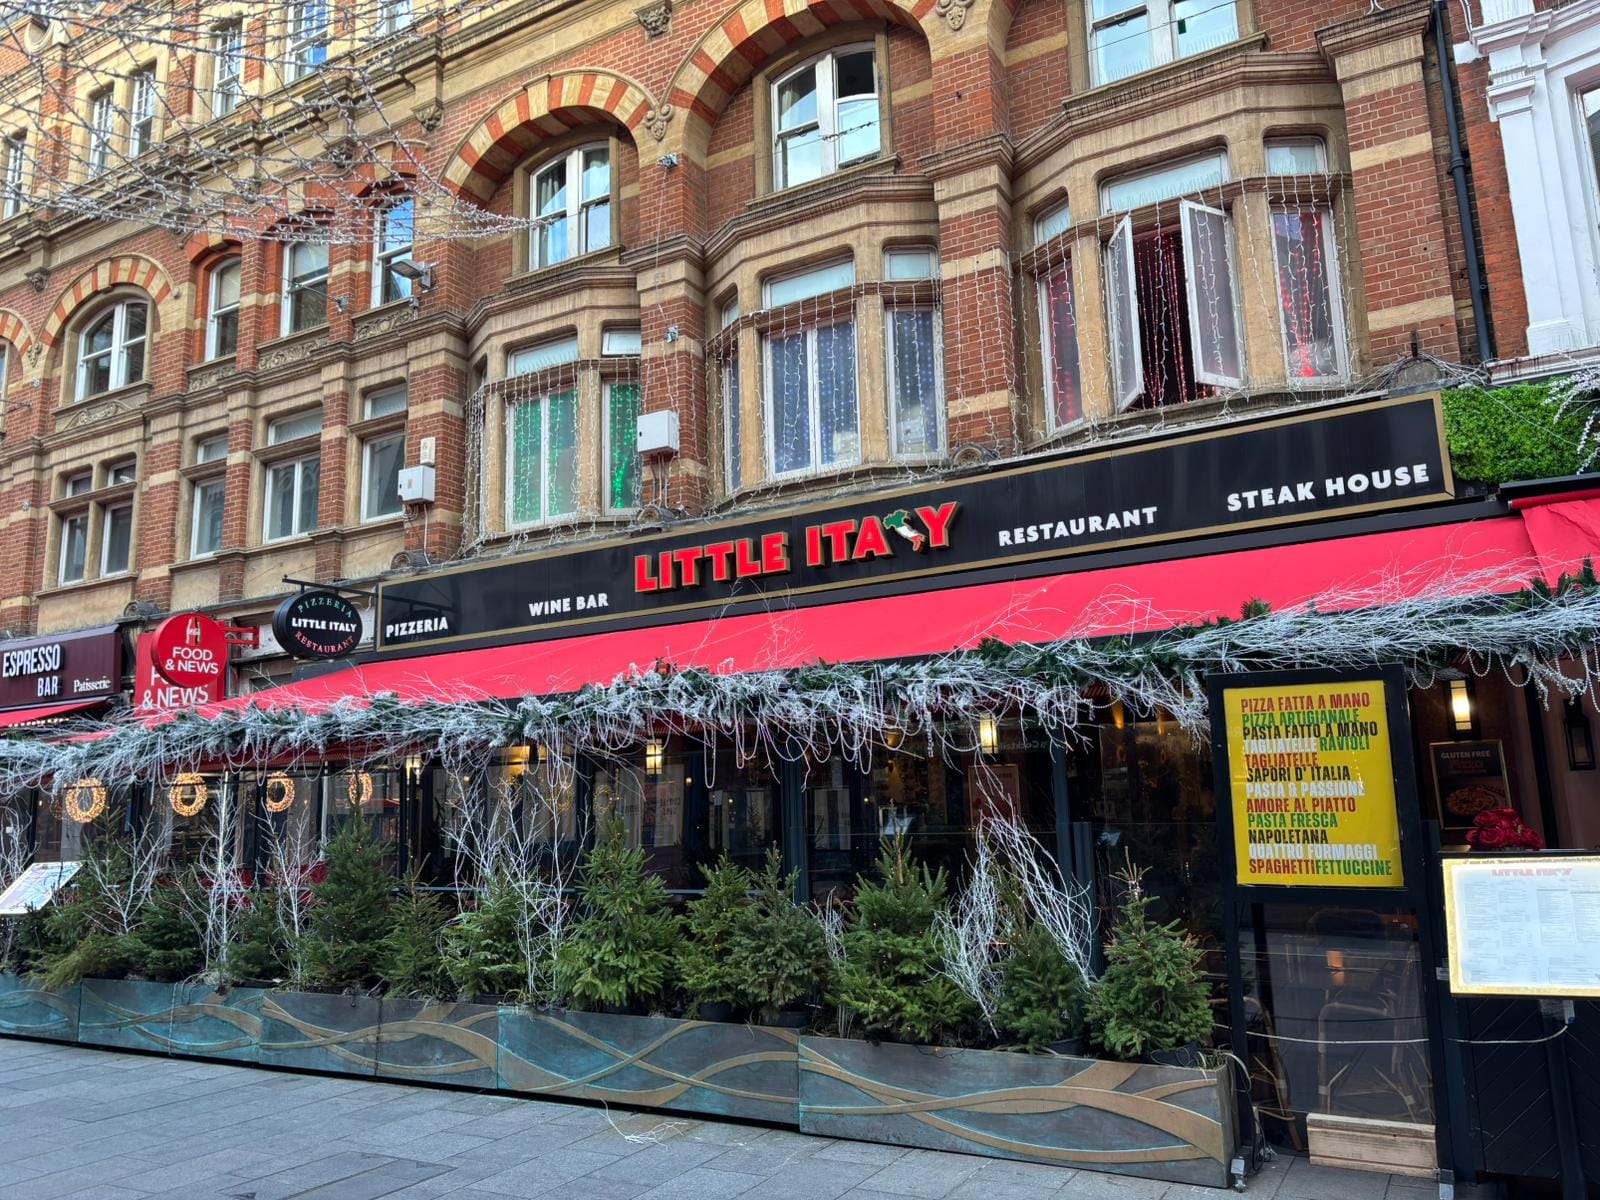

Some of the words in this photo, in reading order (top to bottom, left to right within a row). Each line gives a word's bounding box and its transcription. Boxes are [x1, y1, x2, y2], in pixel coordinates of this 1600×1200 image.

[1227, 481, 1315, 512] STEAK
[1325, 463, 1430, 497] HOUSE
[998, 505, 1159, 547] RESTAURANT
[634, 532, 791, 594] LITTLE
[298, 597, 353, 618] PIZZERIA
[529, 597, 571, 617] WINE
[576, 592, 609, 611] BAR
[292, 617, 327, 630] LITTLE
[329, 622, 356, 633] ITALY
[386, 617, 448, 638] PIZZERIA
[295, 631, 354, 653] RESTAURANT
[2, 644, 60, 678] ESPRESSO
[173, 646, 213, 661] FOOD
[165, 658, 175, 671] &
[177, 659, 219, 675] NEWS
[37, 675, 58, 697] BAR
[73, 675, 112, 693] Patisserie
[143, 689, 153, 710] &
[157, 686, 208, 709] NEWS
[1241, 697, 1275, 713] PIZZA
[1278, 695, 1314, 711] FATTA
[1318, 695, 1326, 709] A
[1330, 692, 1371, 709] MANO
[1242, 713, 1276, 727] PIZZA
[1280, 708, 1359, 726] ARTIGIANALE
[1243, 725, 1281, 740] PASTA
[1285, 723, 1321, 739] FATTO
[1325, 723, 1333, 737] A
[1337, 721, 1378, 737] MANO
[1244, 737, 1317, 753] TAGLIATELLE
[1320, 735, 1370, 751] RAVIOLI
[1245, 752, 1318, 768] TAGLIATELLE
[1441, 751, 1471, 759] GLUTEN
[1472, 750, 1490, 758] FREE
[1246, 767, 1294, 783] SAPORI
[1311, 766, 1351, 782] ITALIA
[1247, 782, 1285, 797] PASTA
[1302, 780, 1365, 796] PASSIONE
[1247, 798, 1289, 812] AMORE
[1294, 798, 1308, 812] AL
[1312, 797, 1356, 812] PIATTO
[1248, 813, 1286, 828] PASTA
[1291, 812, 1338, 828] FRESCA
[1249, 829, 1328, 844] NAPOLETANA
[1308, 843, 1378, 859] FORMAGGI
